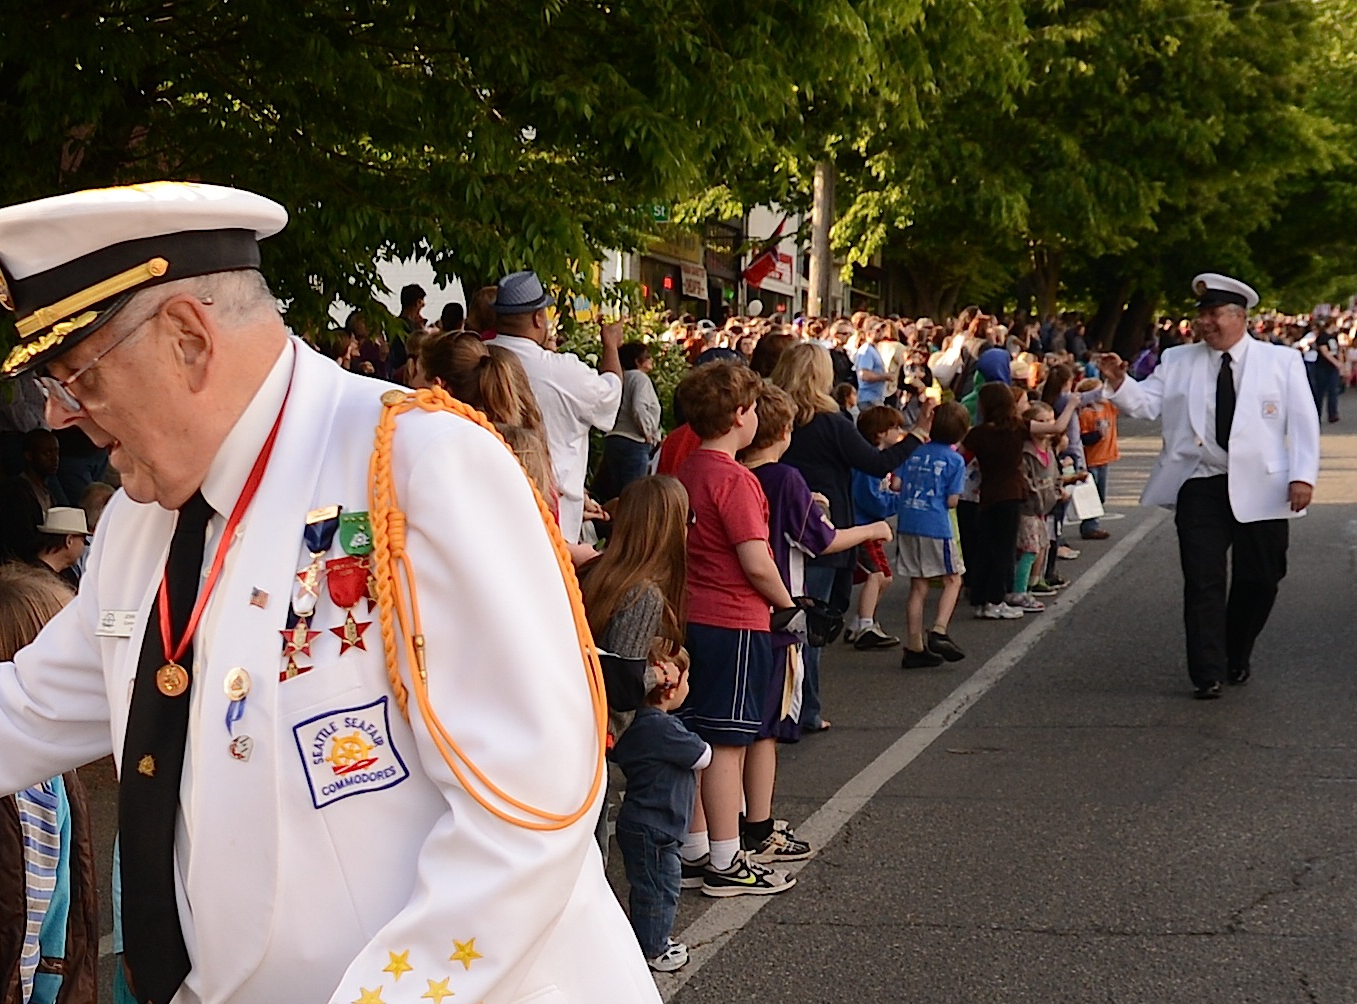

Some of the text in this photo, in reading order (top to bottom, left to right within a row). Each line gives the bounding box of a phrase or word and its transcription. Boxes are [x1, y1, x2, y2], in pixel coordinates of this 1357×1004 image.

[653, 205, 665, 217] St
[312, 717, 384, 765] SEATTLE SEAFAIR
[321, 765, 397, 796] COMMODORES
